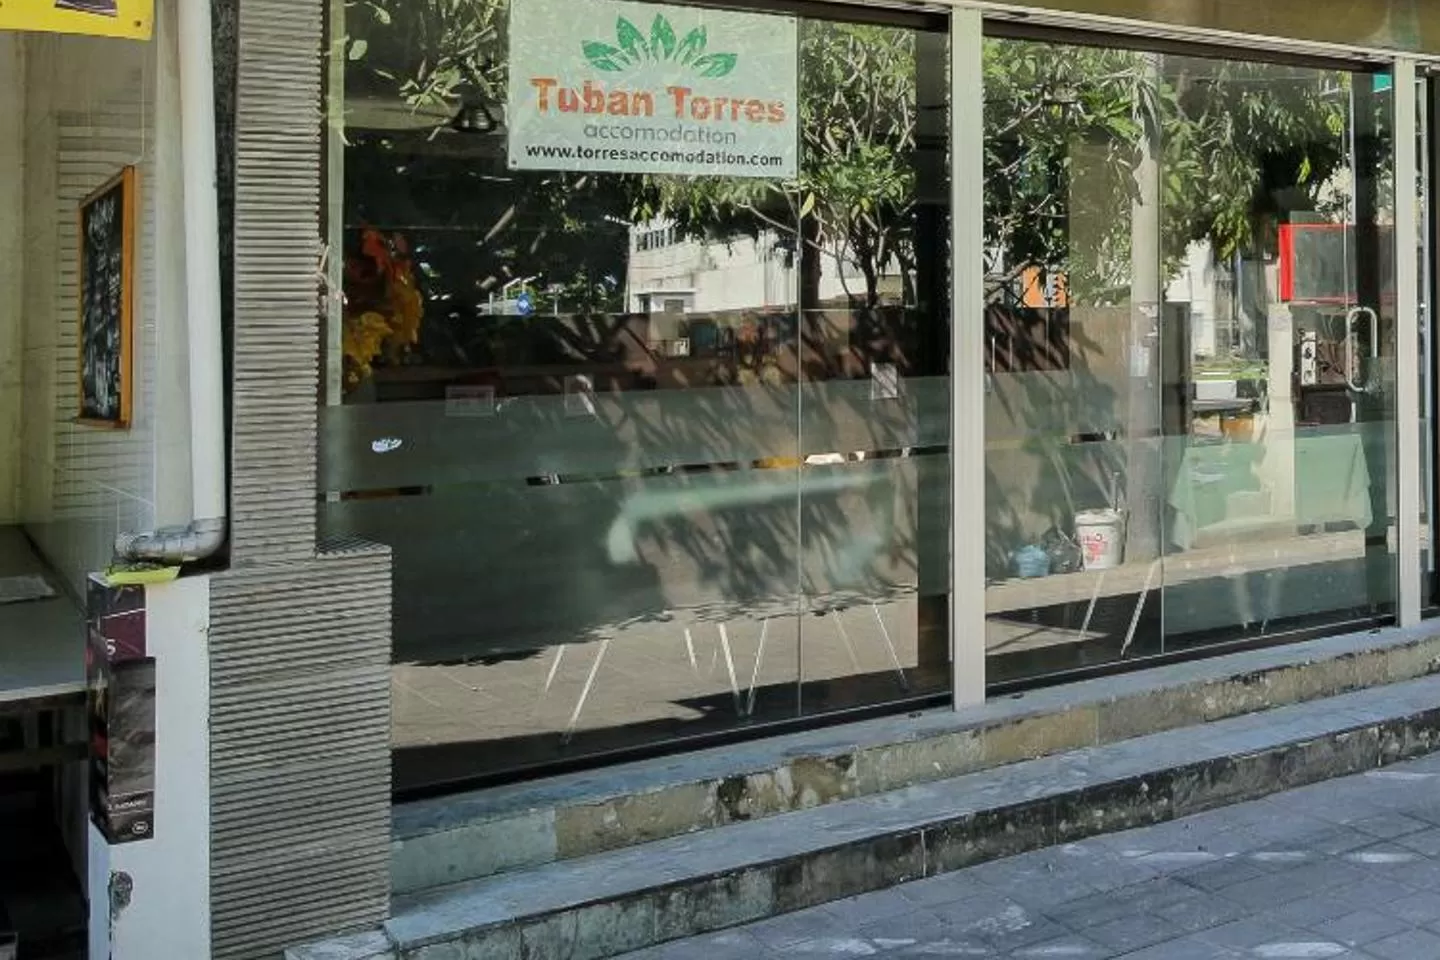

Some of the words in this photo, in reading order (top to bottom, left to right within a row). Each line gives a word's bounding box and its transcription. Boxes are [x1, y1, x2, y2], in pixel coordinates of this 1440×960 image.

[529, 78, 654, 117] Tuban
[666, 86, 786, 123] Torres
[584, 122, 736, 144] accomodation
[525, 144, 783, 167] www.torresaccomodation.com
